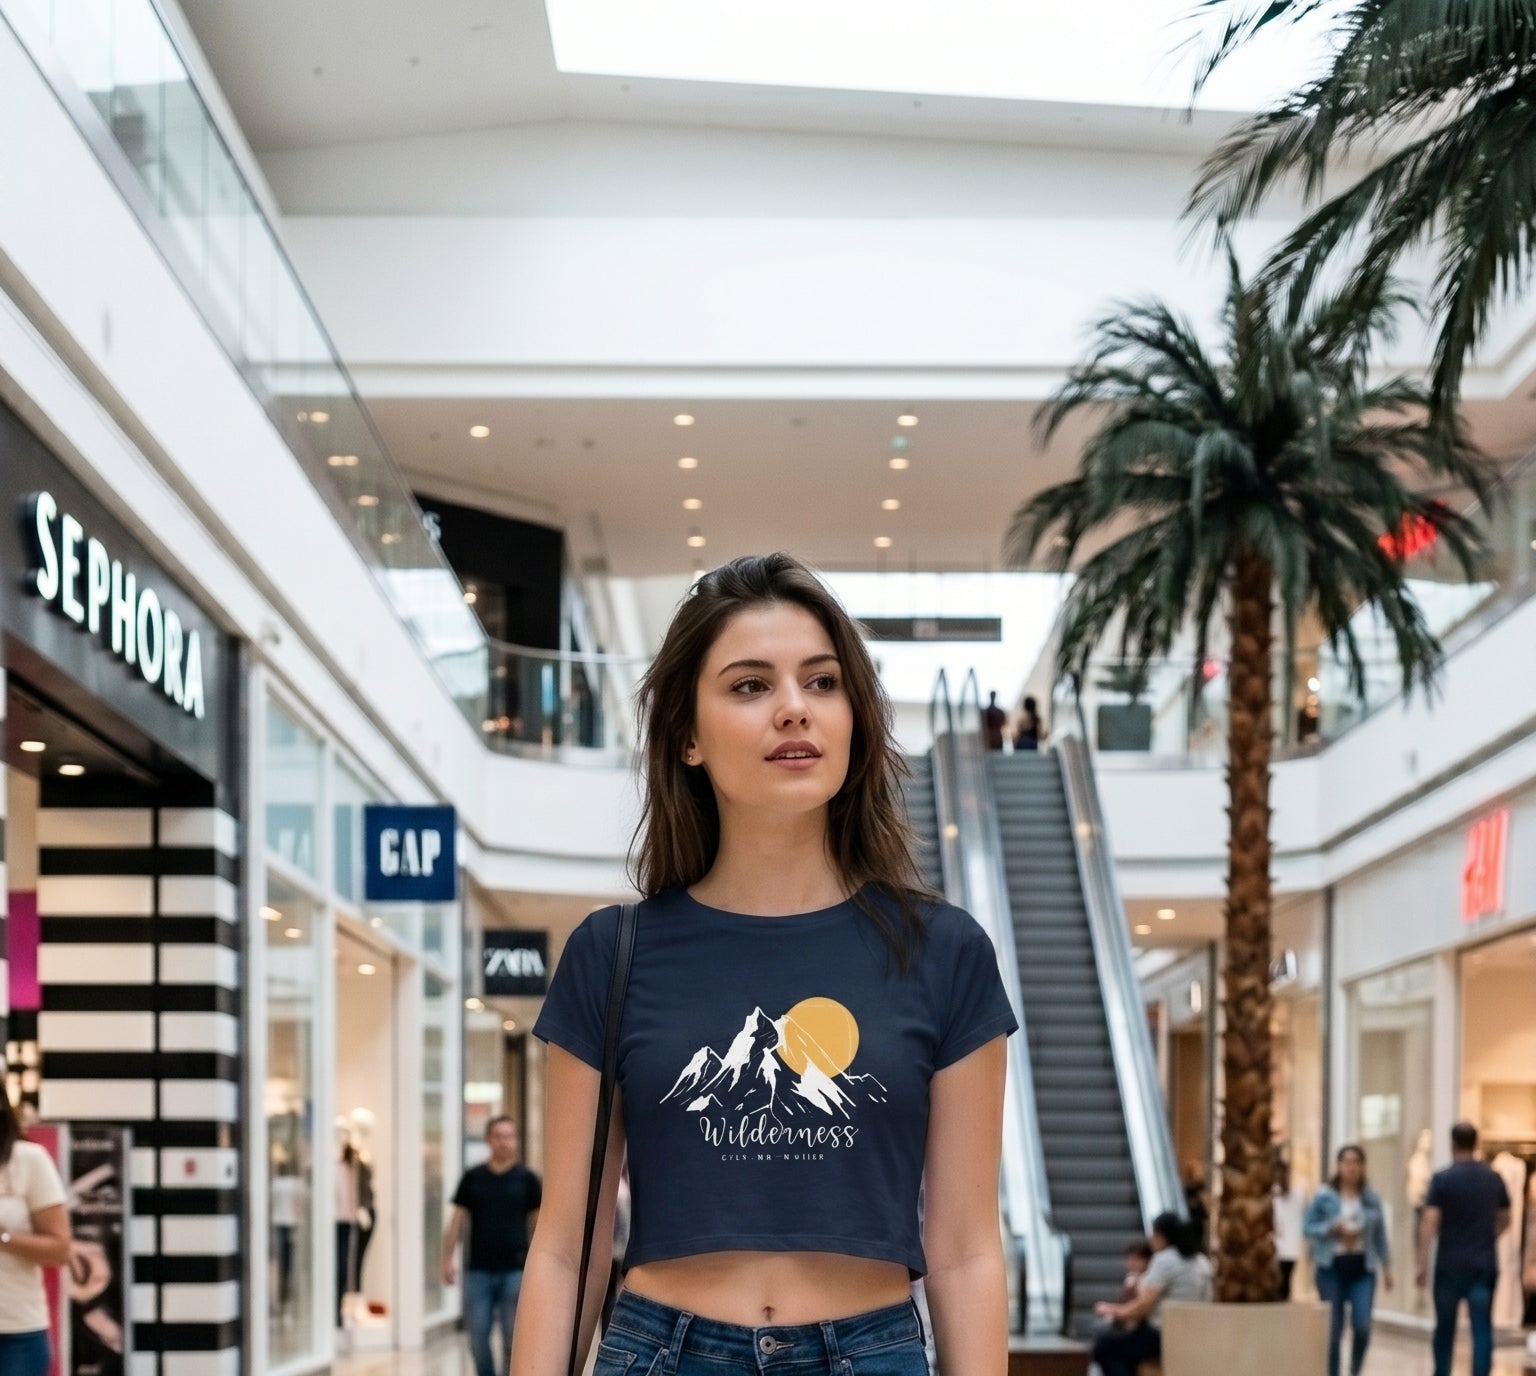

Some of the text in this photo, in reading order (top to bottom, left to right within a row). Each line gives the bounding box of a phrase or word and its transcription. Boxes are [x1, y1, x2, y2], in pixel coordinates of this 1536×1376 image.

[36, 490, 206, 720] SEPHORA
[380, 827, 442, 878] GAP
[699, 1113, 859, 1148] Wilderness
